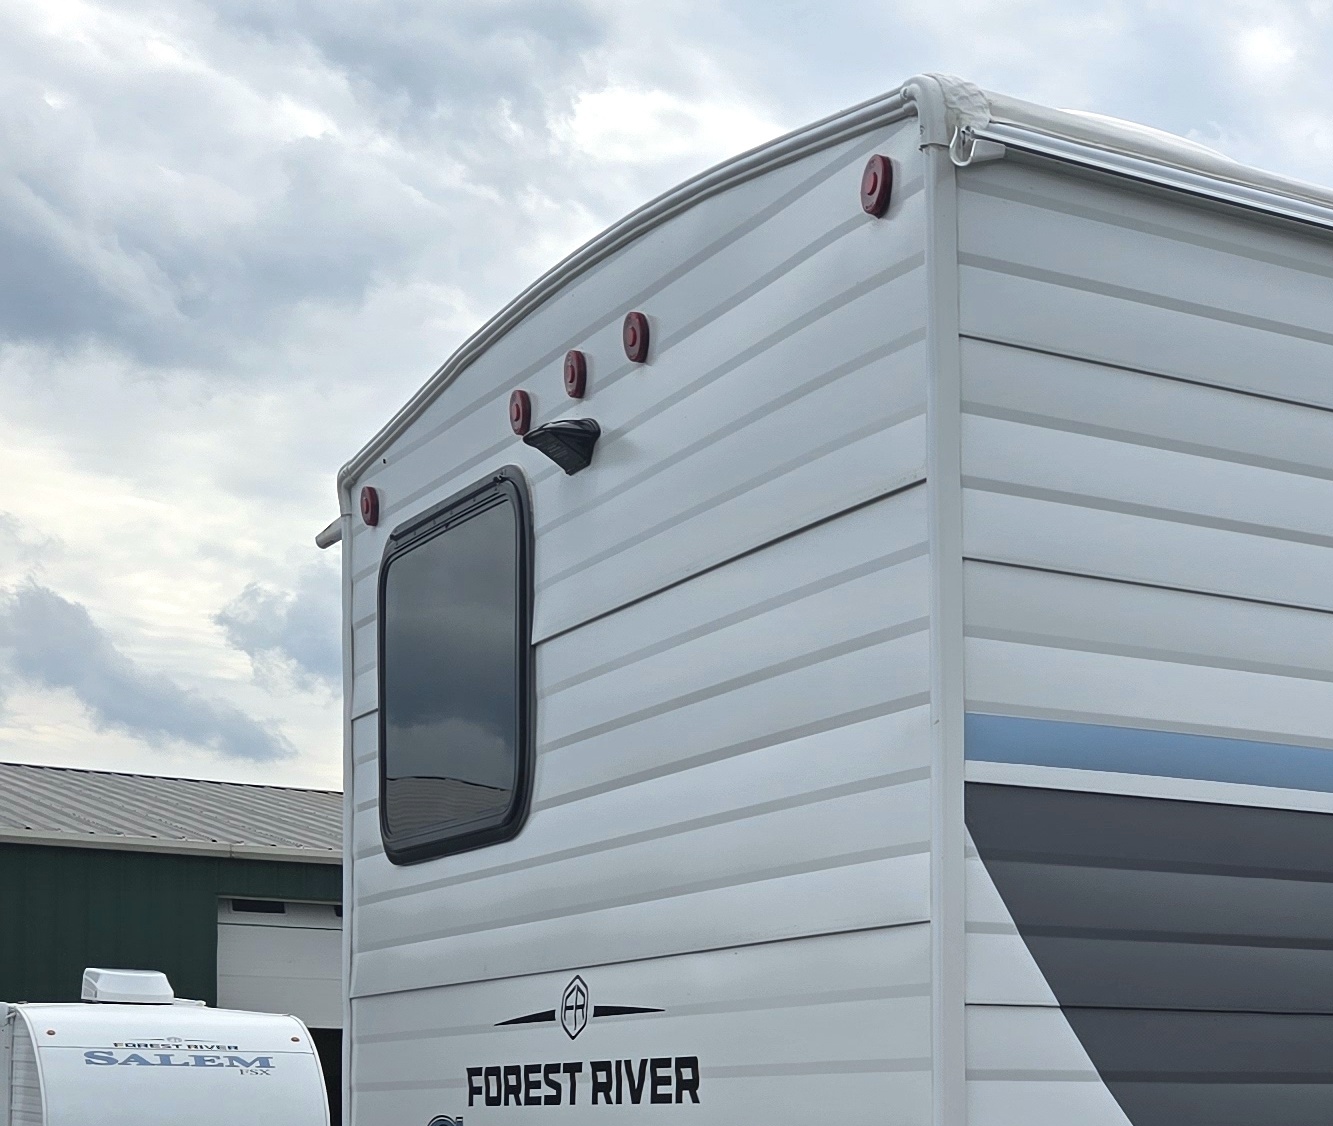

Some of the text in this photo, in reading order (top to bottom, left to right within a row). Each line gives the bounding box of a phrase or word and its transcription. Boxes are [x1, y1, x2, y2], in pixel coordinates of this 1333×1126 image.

[83, 1051, 276, 1069] SALEM
[466, 1055, 701, 1107] FOREST RIVER
